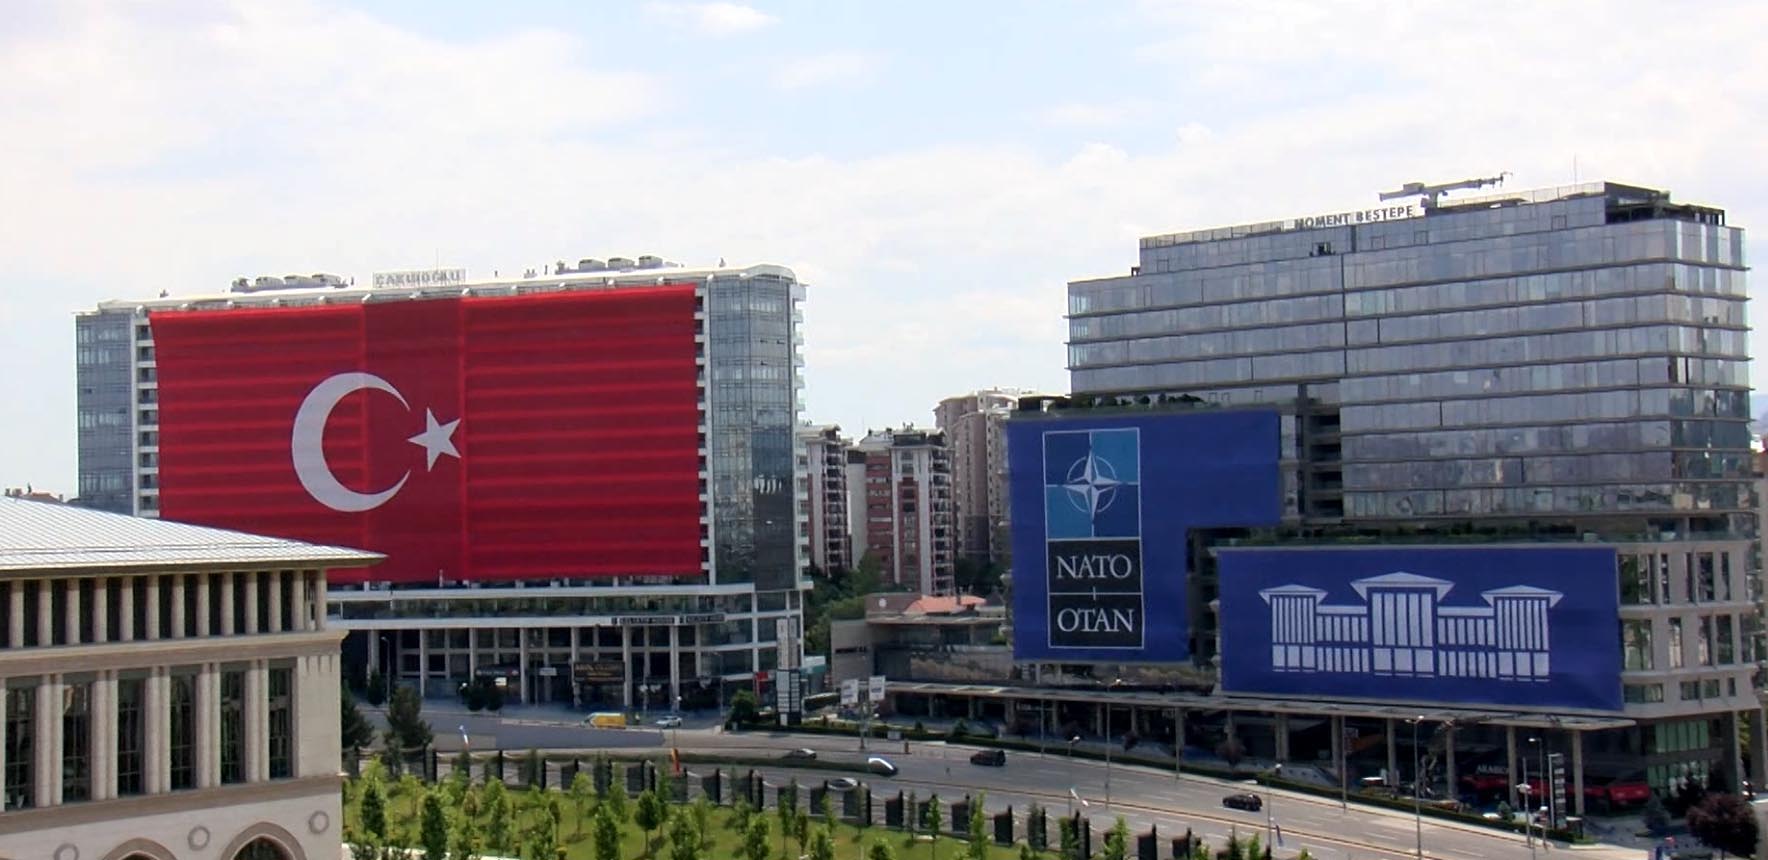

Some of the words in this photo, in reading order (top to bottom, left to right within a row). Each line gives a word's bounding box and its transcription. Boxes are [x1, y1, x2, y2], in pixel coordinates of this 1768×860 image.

[1294, 213, 1350, 229] MOMENT
[1056, 554, 1132, 579] NATO
[1057, 608, 1134, 632] OTAN
